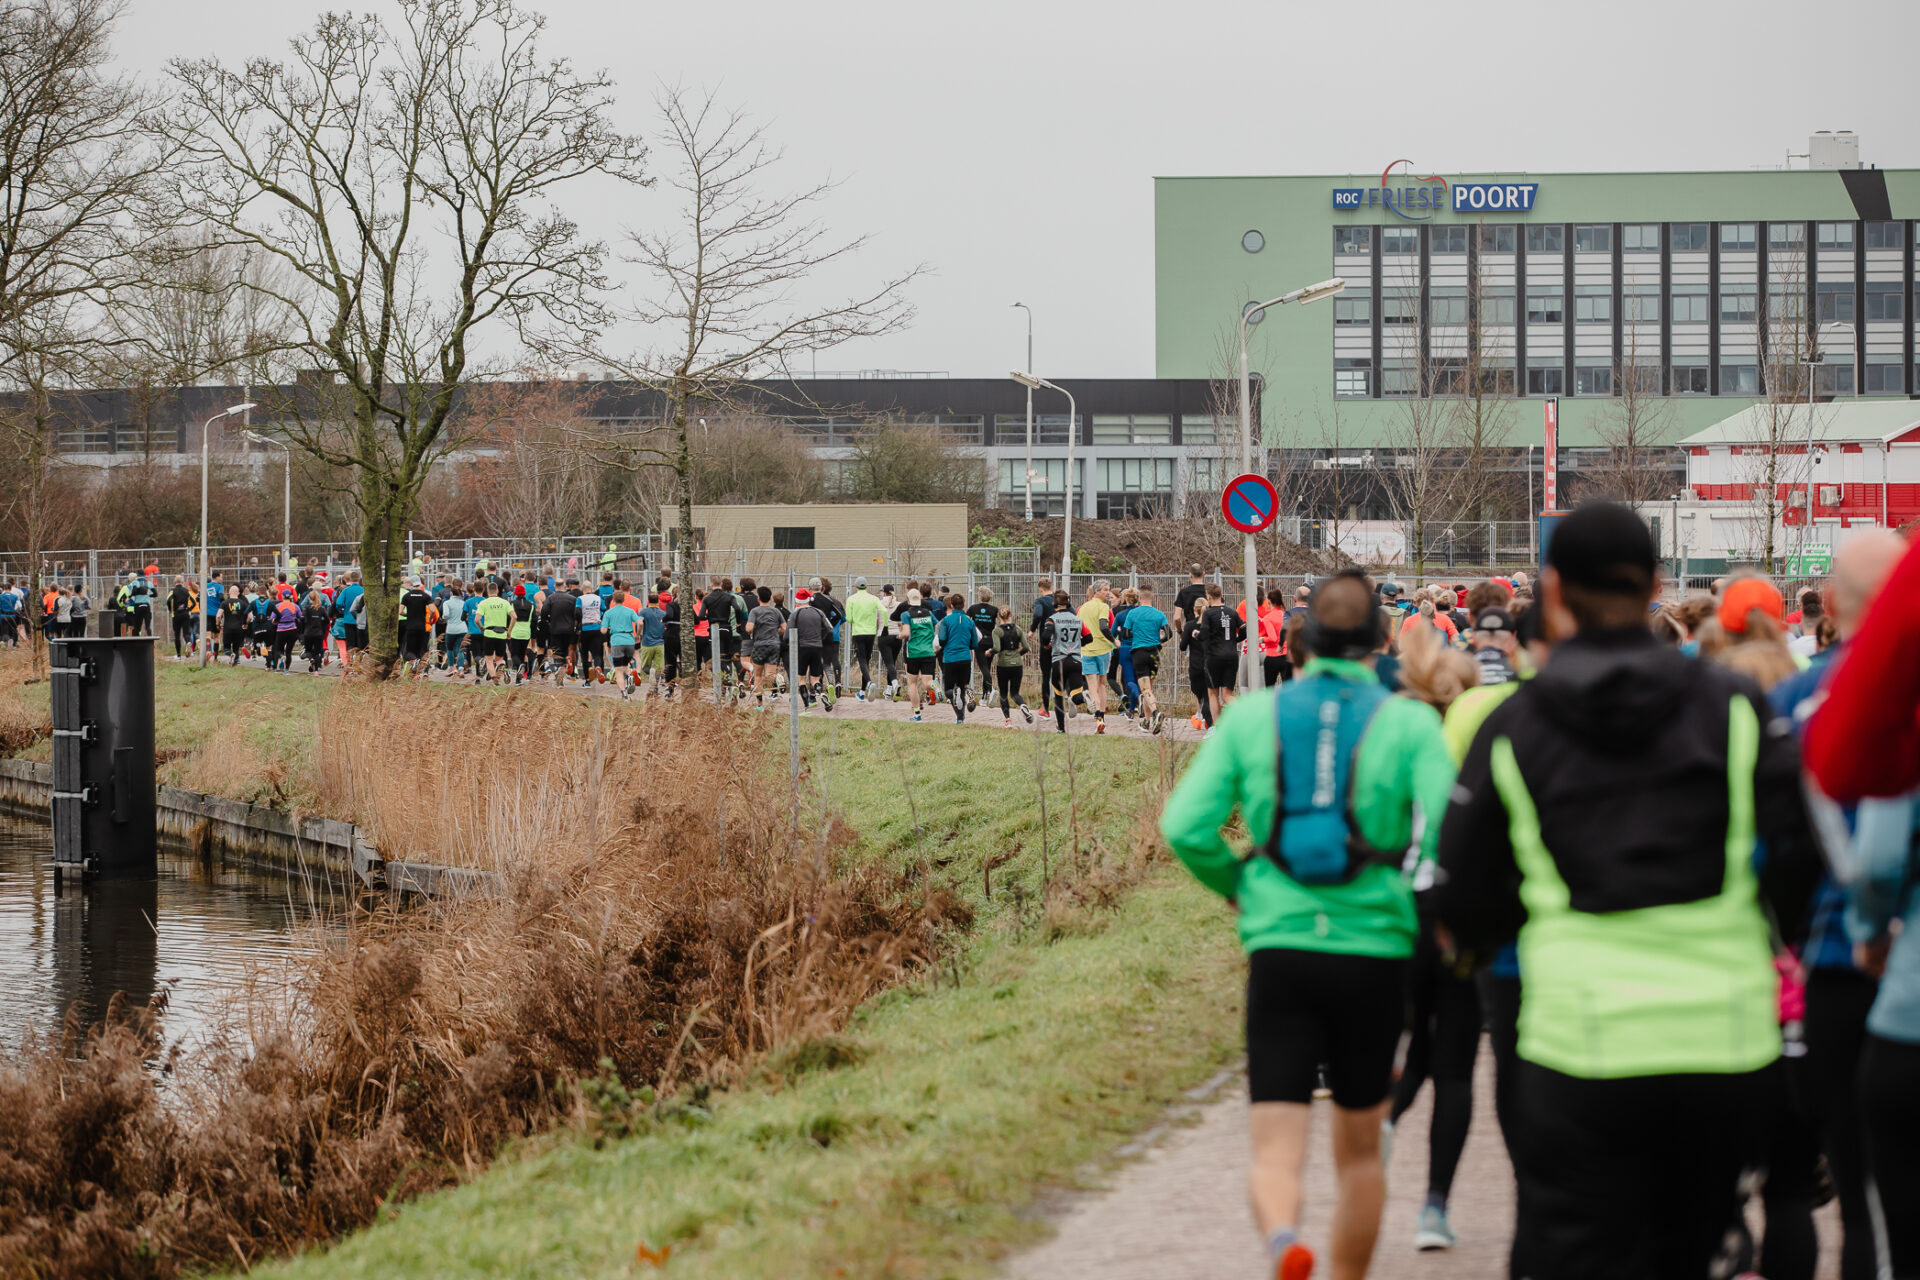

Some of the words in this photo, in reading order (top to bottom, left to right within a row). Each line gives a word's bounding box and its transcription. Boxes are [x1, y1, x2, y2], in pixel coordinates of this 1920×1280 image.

[1336, 193, 1358, 204] ROC
[1368, 187, 1444, 209] FRIESE
[1455, 186, 1534, 208] POORT
[1060, 627, 1079, 643] 37
